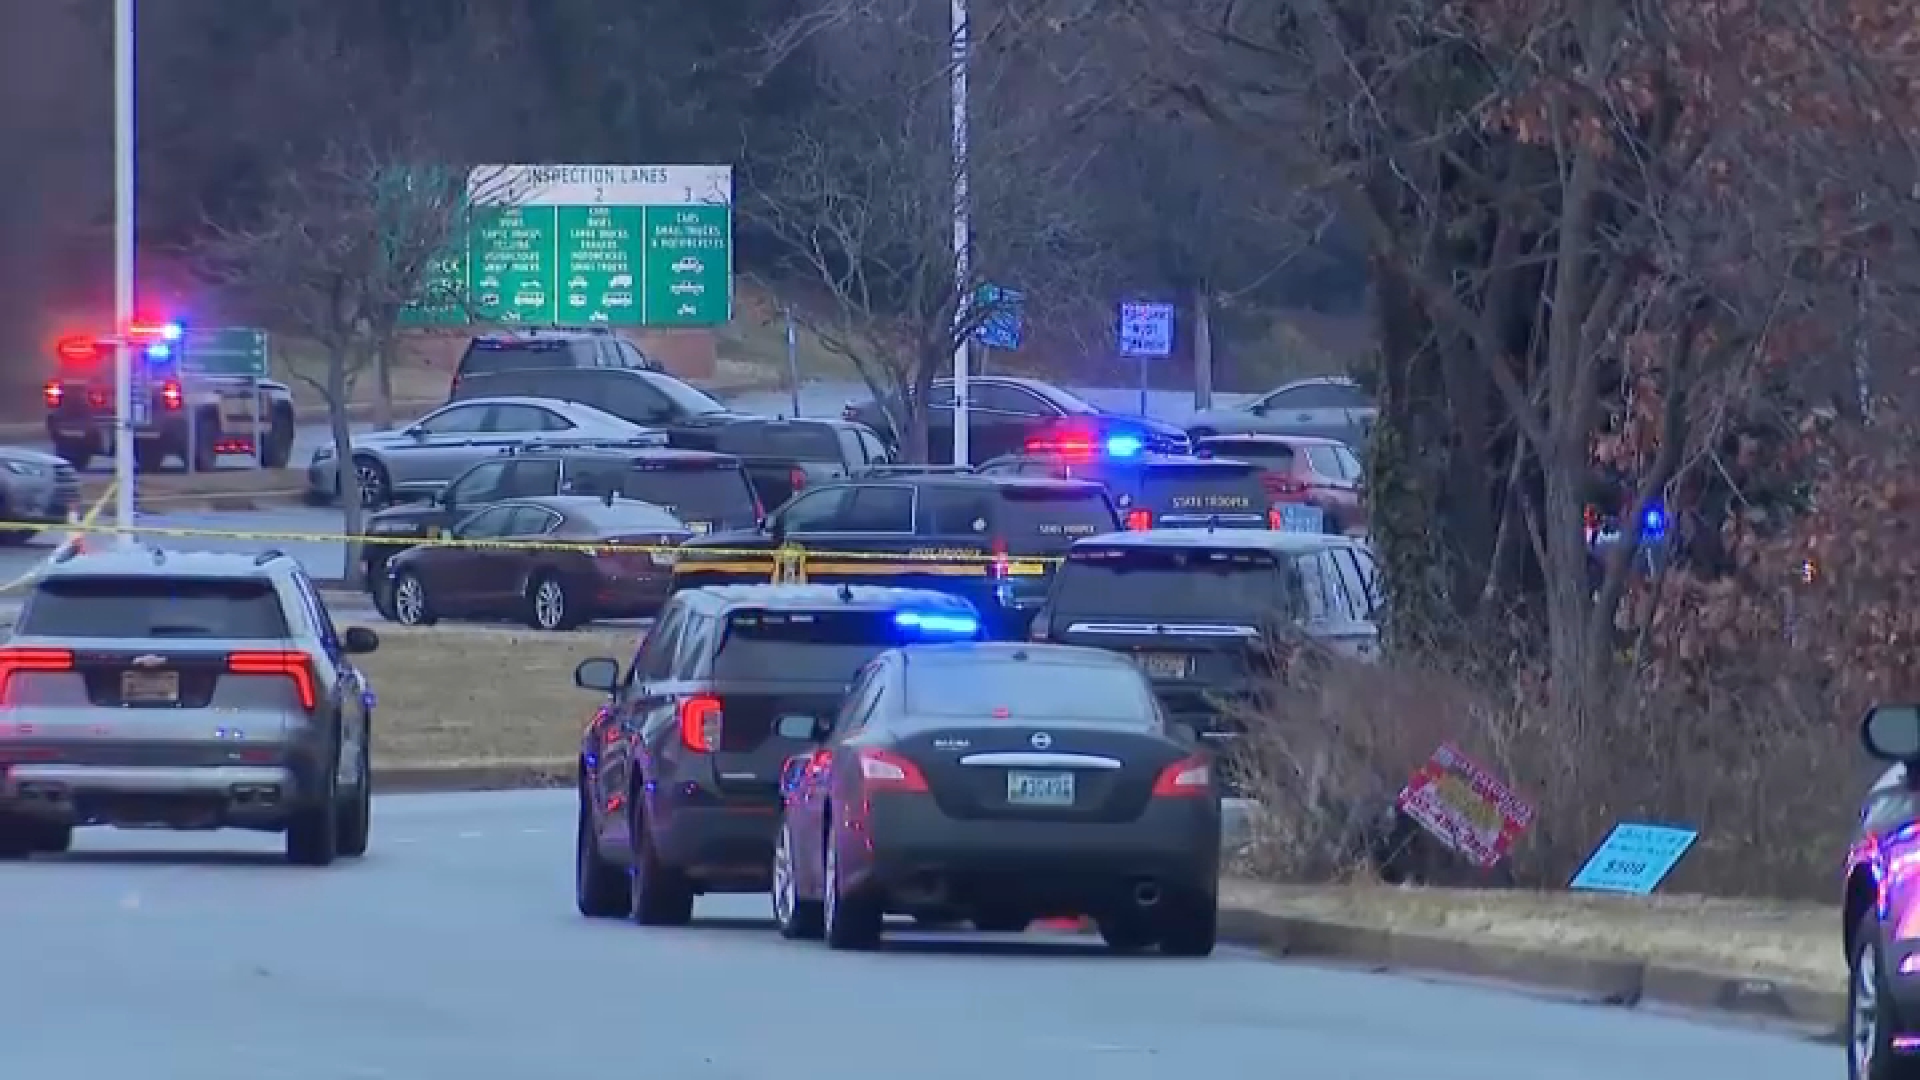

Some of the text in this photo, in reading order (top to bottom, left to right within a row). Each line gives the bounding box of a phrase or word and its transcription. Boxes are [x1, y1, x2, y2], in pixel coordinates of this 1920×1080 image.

[528, 168, 668, 185] INSPECTION LANES
[596, 187, 604, 201] 2
[684, 186, 692, 202] 3
[1172, 496, 1249, 508] STATE TROOPER
